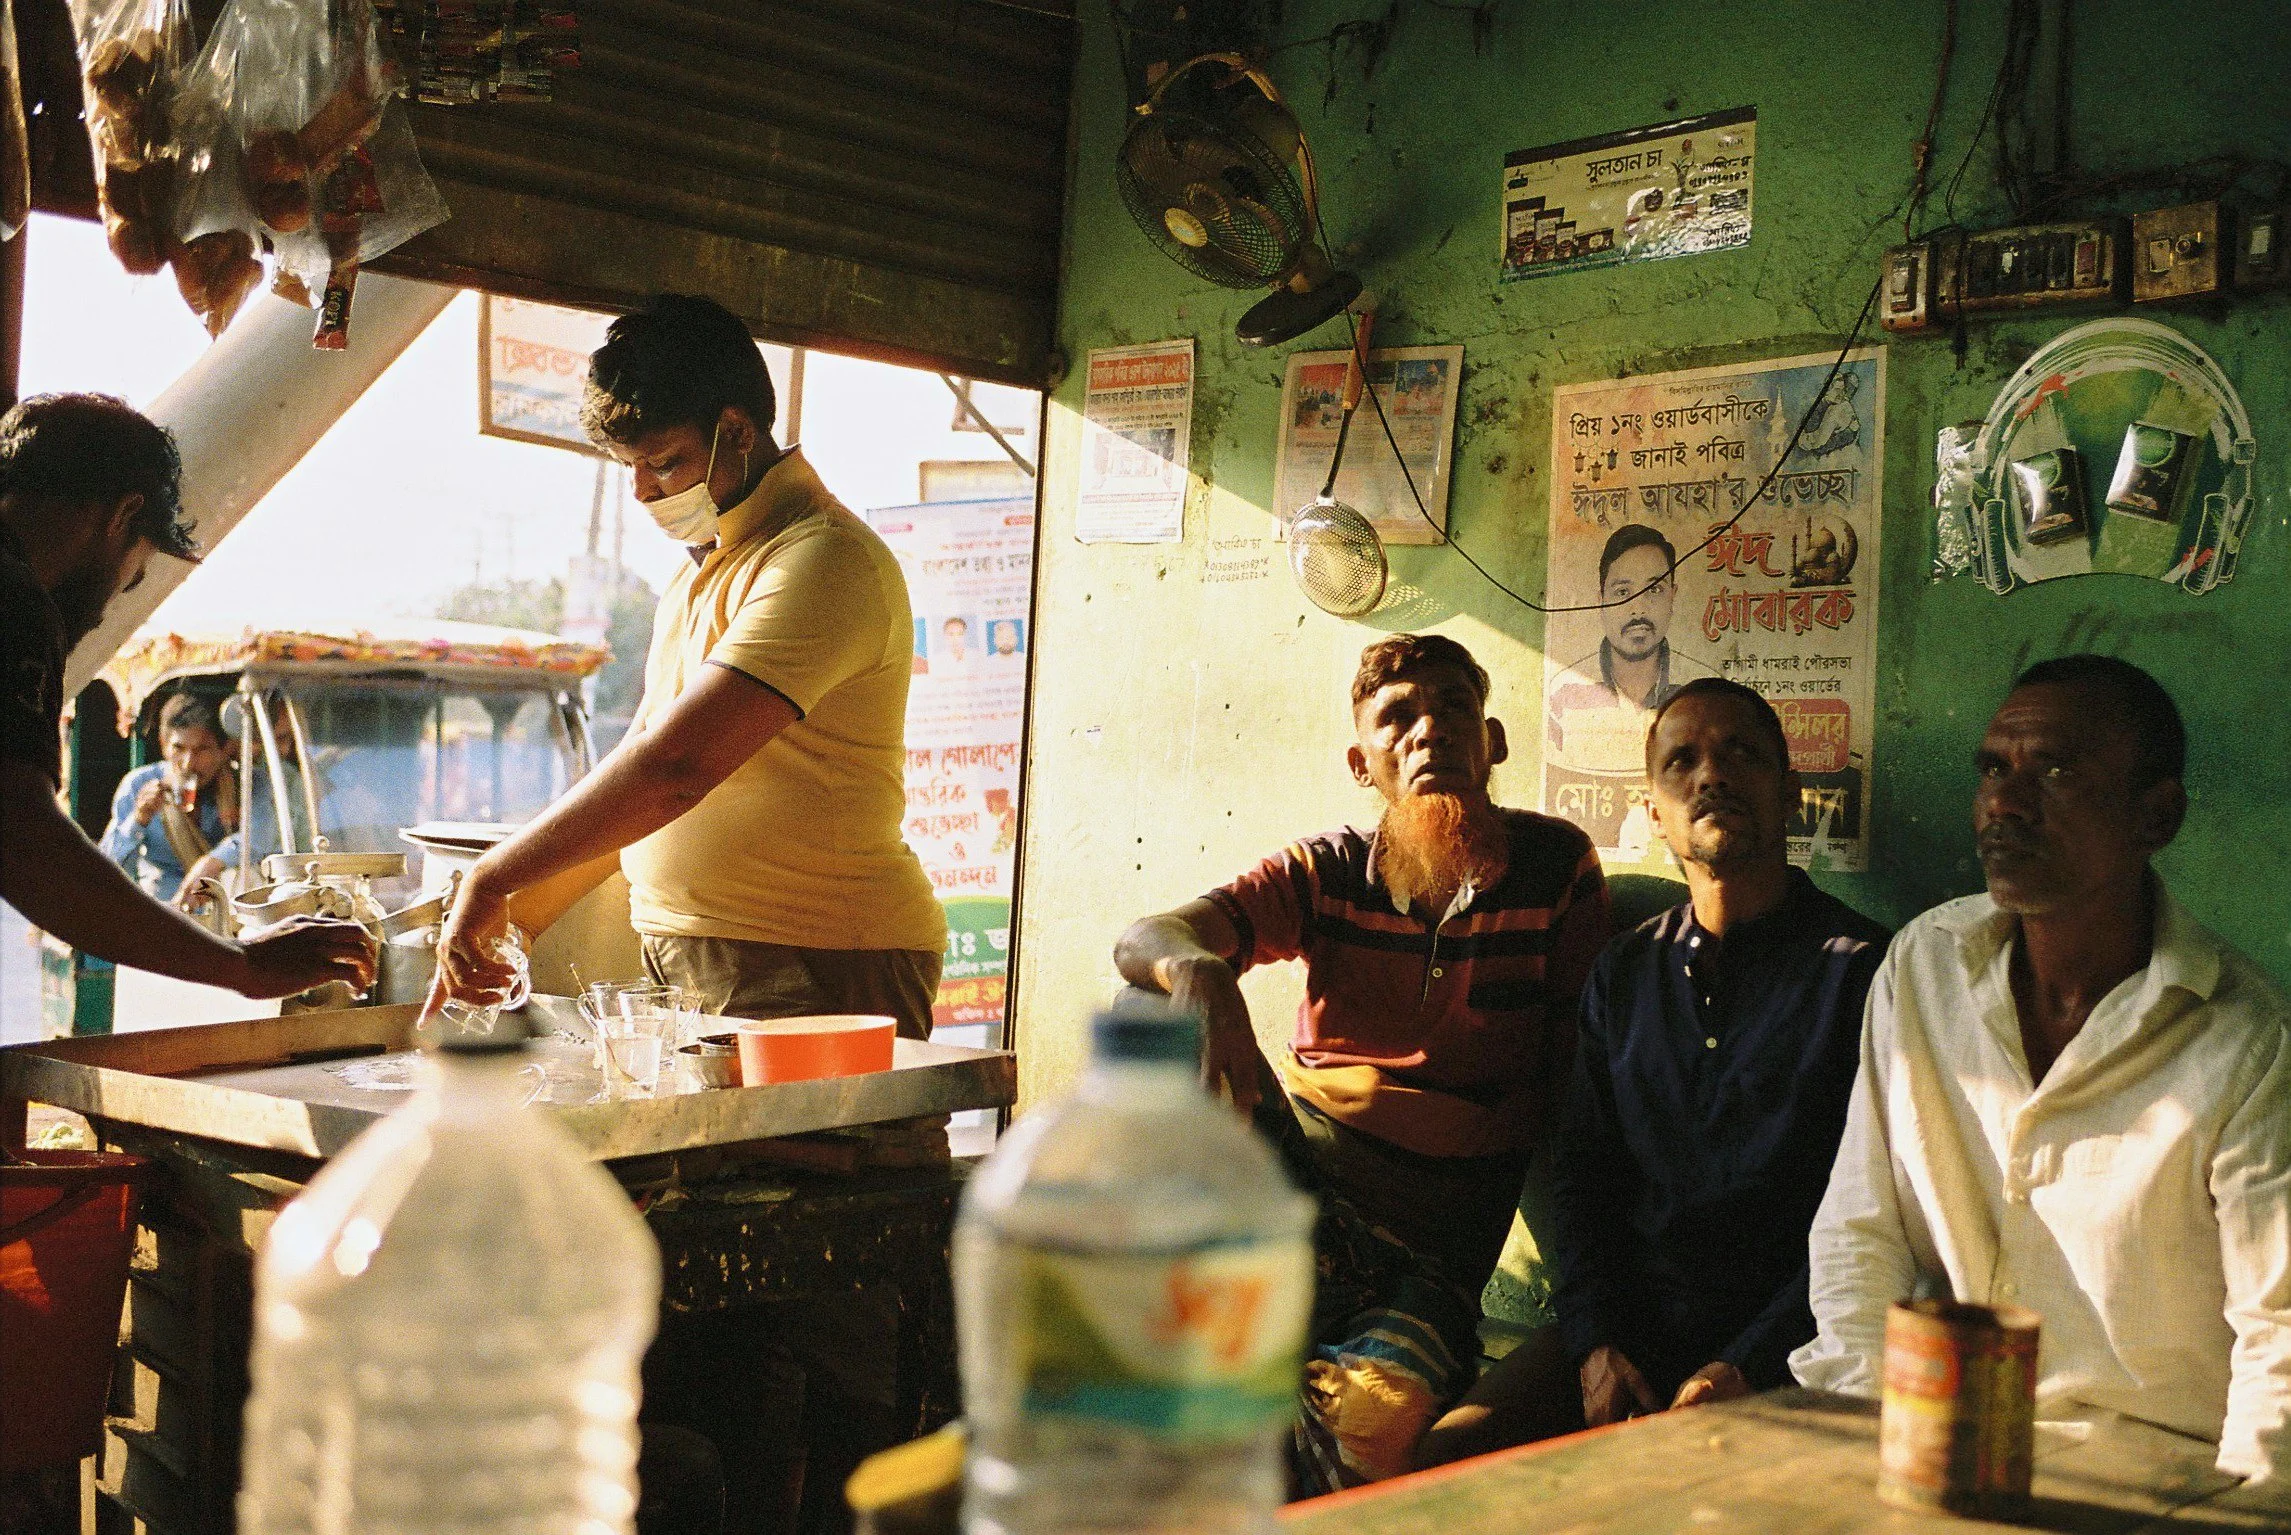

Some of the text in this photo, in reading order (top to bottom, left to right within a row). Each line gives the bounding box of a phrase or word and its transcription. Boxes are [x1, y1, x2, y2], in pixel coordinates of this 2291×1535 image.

[1586, 153, 1642, 183] সুলতান
[1646, 149, 1663, 168] চা
[1570, 394, 1769, 438] প্রিয় ১নং ওয়ার্ডবাসীকে
[1630, 436, 1746, 469] জানাই পবিত্র
[1571, 481, 1630, 525] ঈদুল
[1757, 466, 1858, 508] শুভেচ্ছা
[1703, 520, 1785, 577] ঈদ
[1702, 586, 1858, 641] মোবারক
[1762, 655, 1801, 671] ধামরাই
[1804, 653, 1852, 671] পৌরসভা
[1776, 680, 1796, 694] ১নং
[1800, 675, 1842, 693] ওয়ার্ডের
[941, 742, 1019, 777] গোলাপে
[1555, 779, 1614, 819] মোঃ
